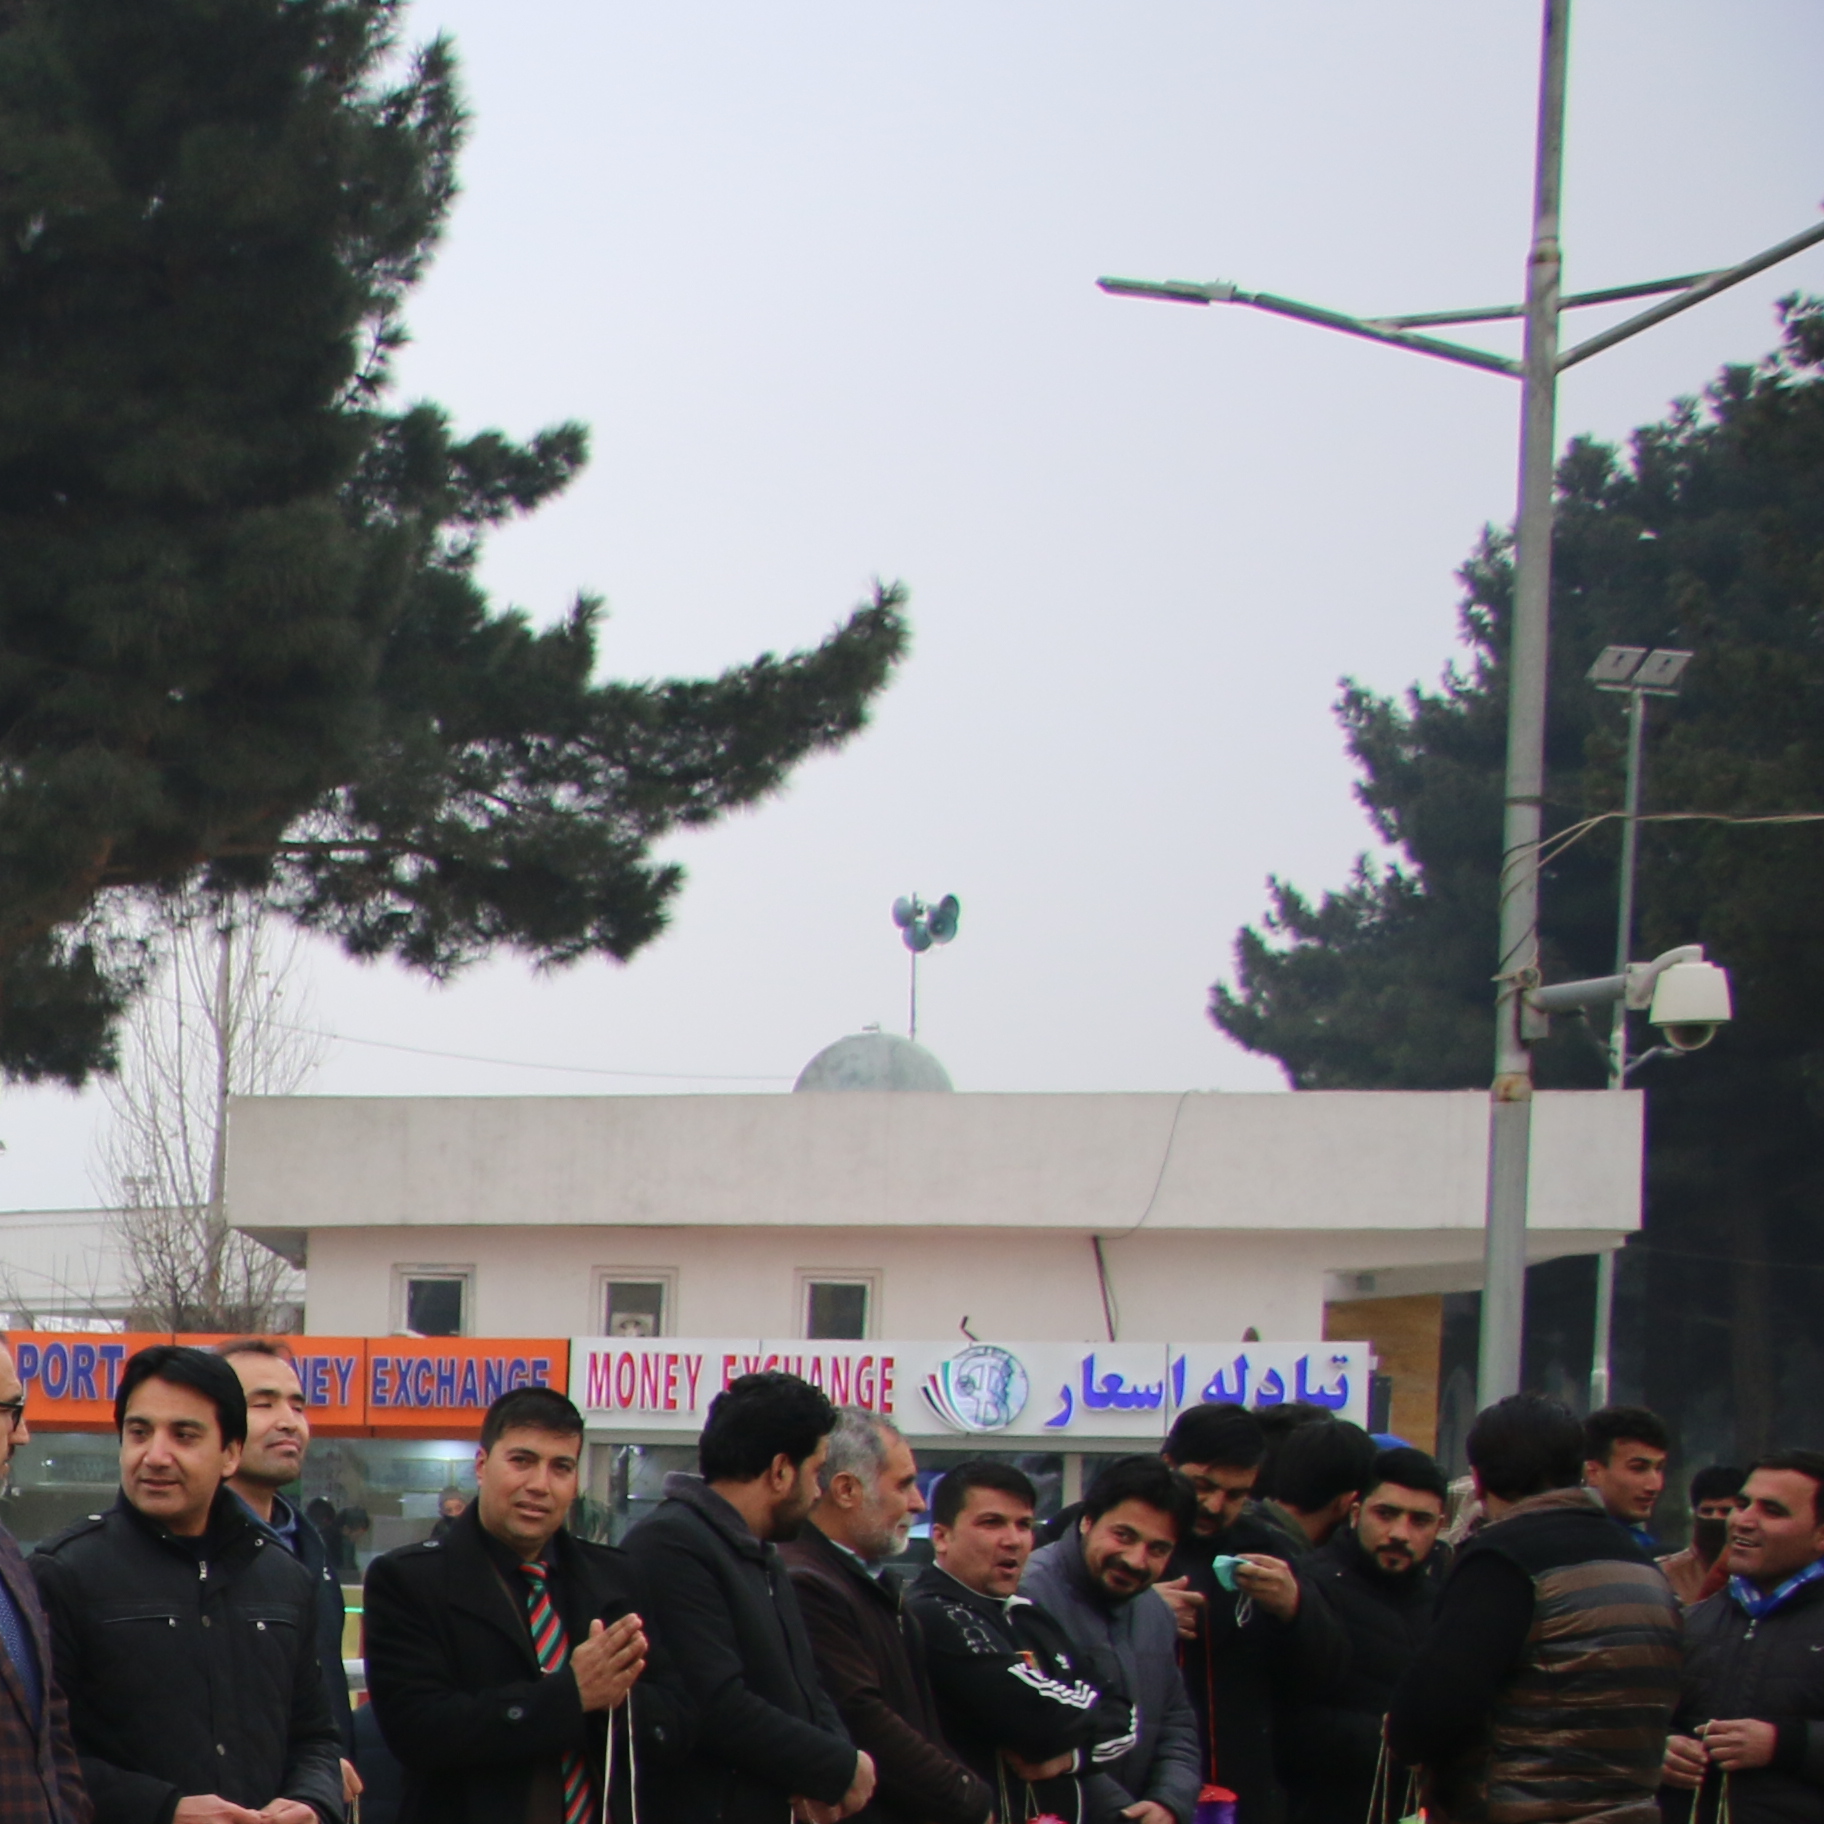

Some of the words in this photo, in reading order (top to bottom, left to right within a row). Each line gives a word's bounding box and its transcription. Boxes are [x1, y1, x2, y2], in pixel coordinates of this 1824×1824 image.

[17, 1342, 126, 1400] PORT
[585, 1350, 704, 1412] MONEY
[1044, 1352, 1186, 1429] اسعار
